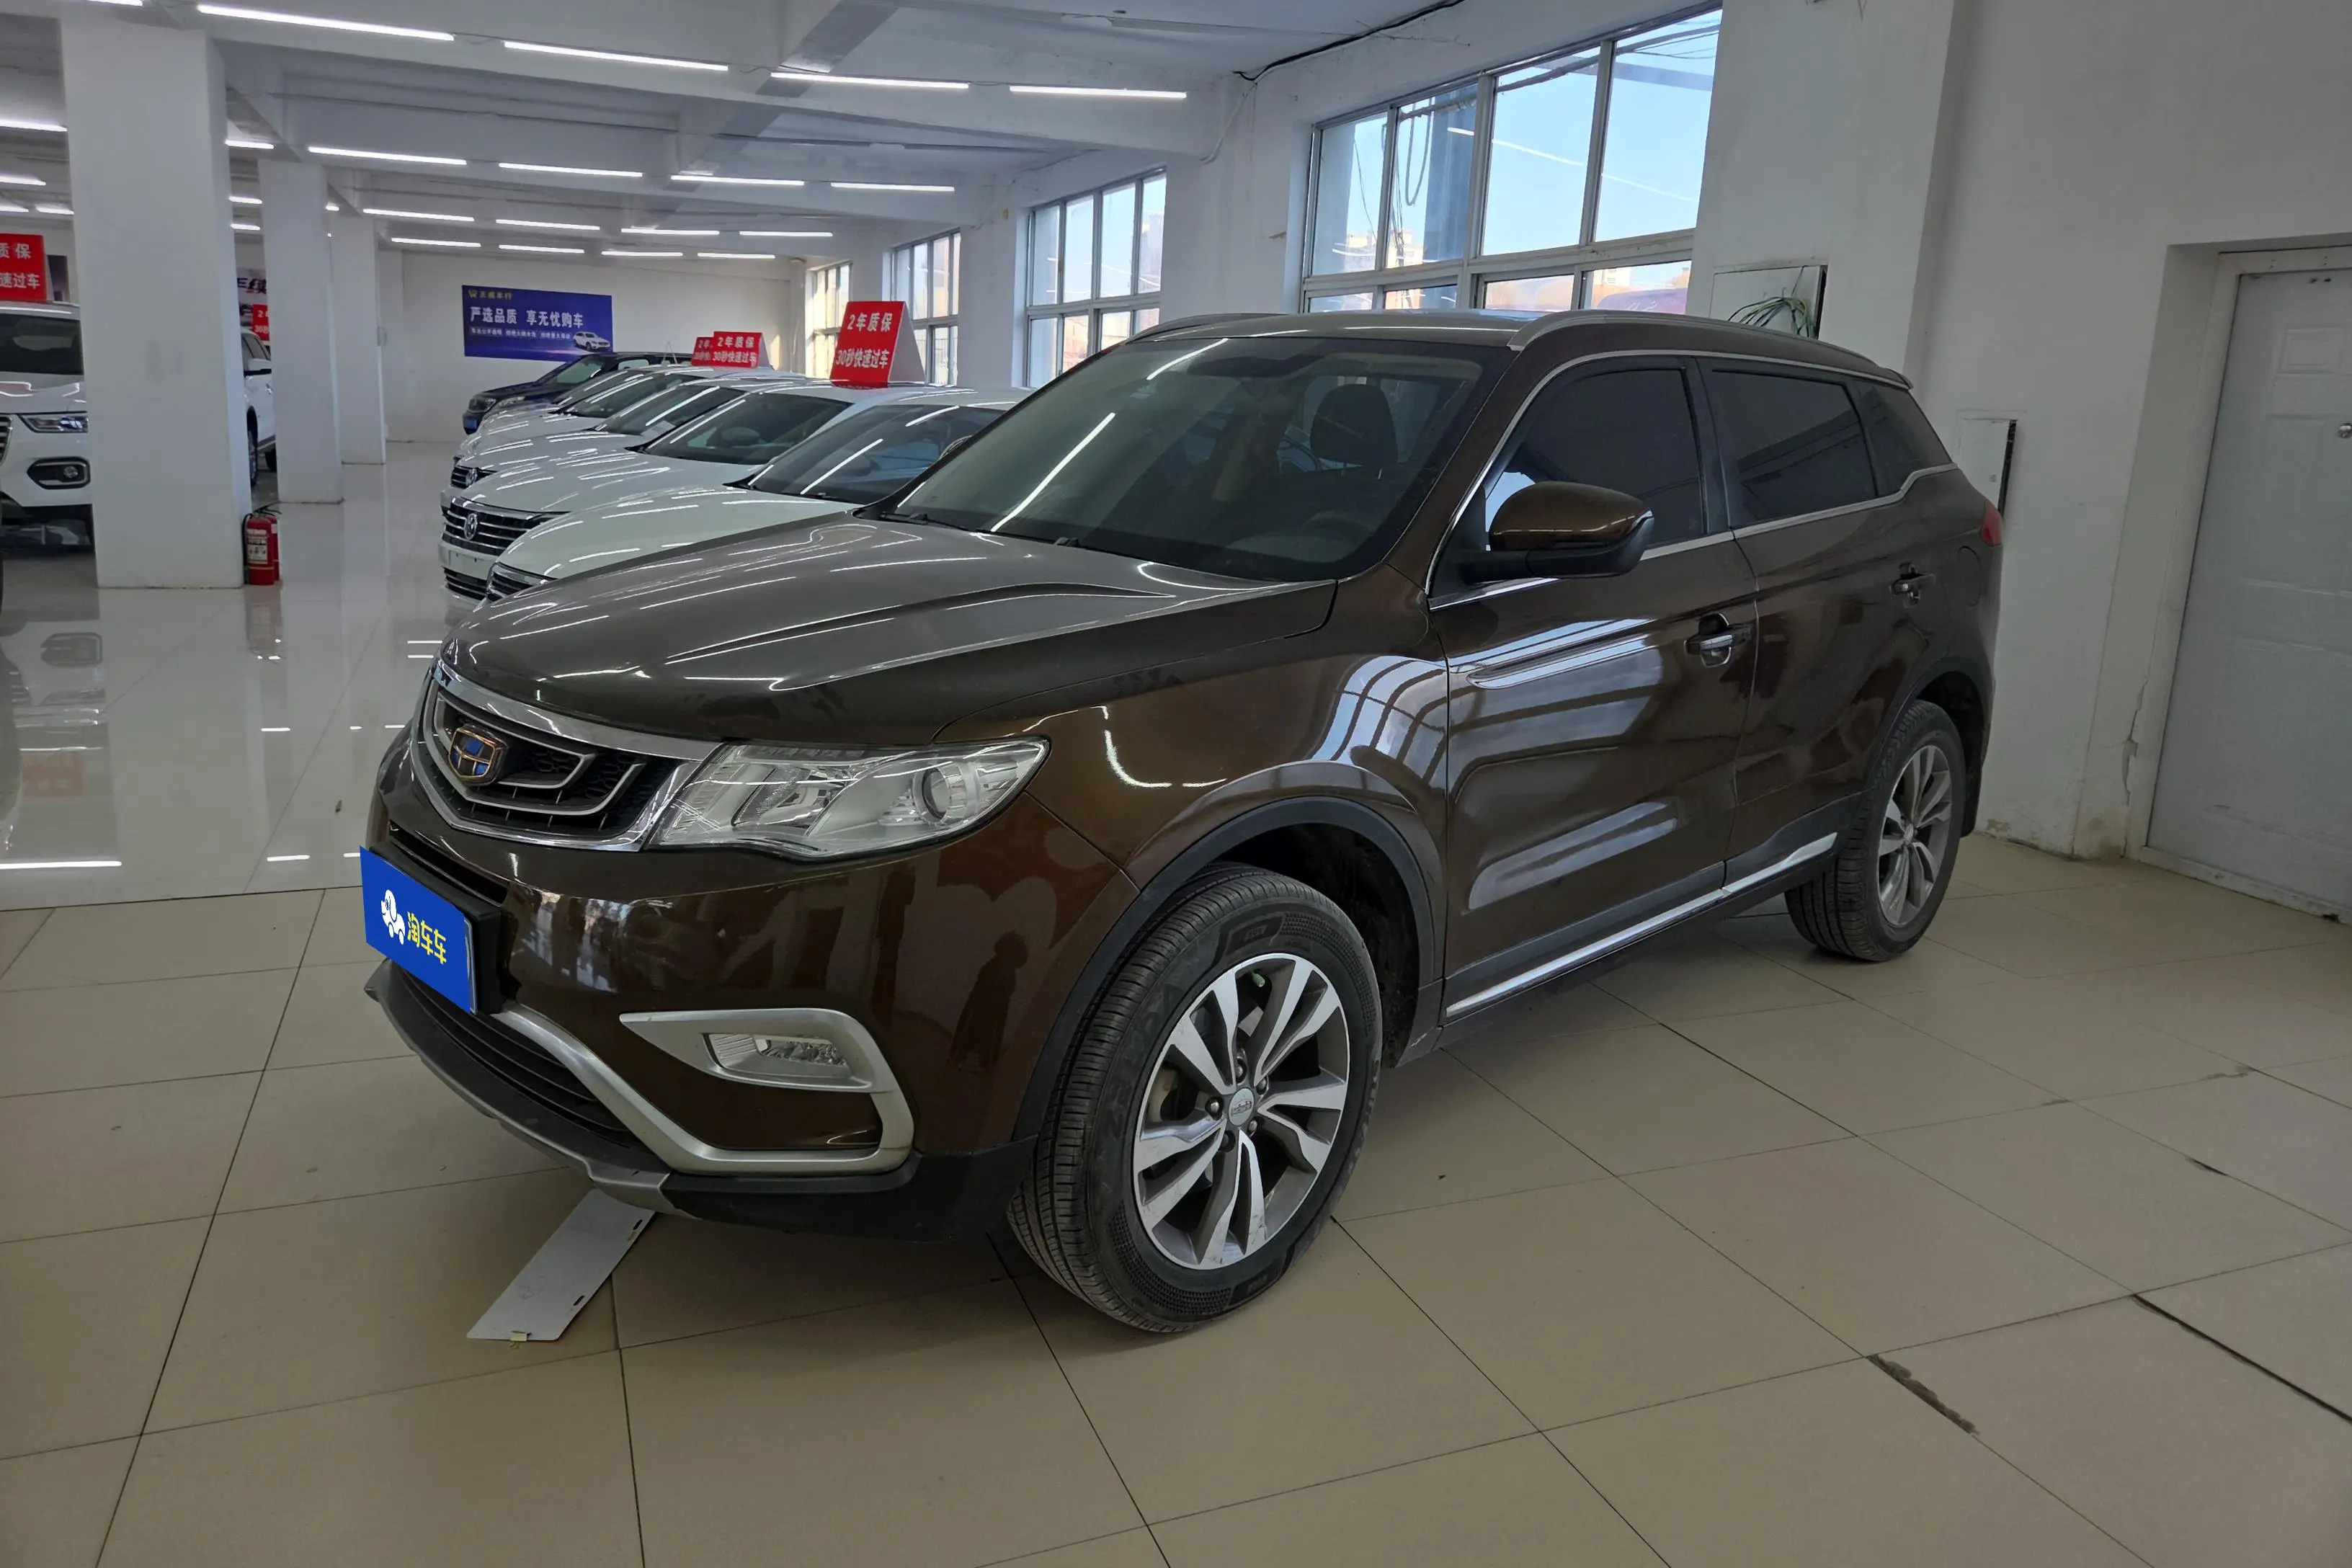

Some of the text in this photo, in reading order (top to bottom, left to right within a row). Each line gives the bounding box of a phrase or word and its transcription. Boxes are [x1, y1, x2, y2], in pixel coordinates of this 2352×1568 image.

[470, 306, 584, 329] 严选品质 享无忧购车
[847, 312, 894, 332] 2年质保
[717, 335, 754, 349] 2年质保
[835, 347, 890, 369] 30秒快速过车
